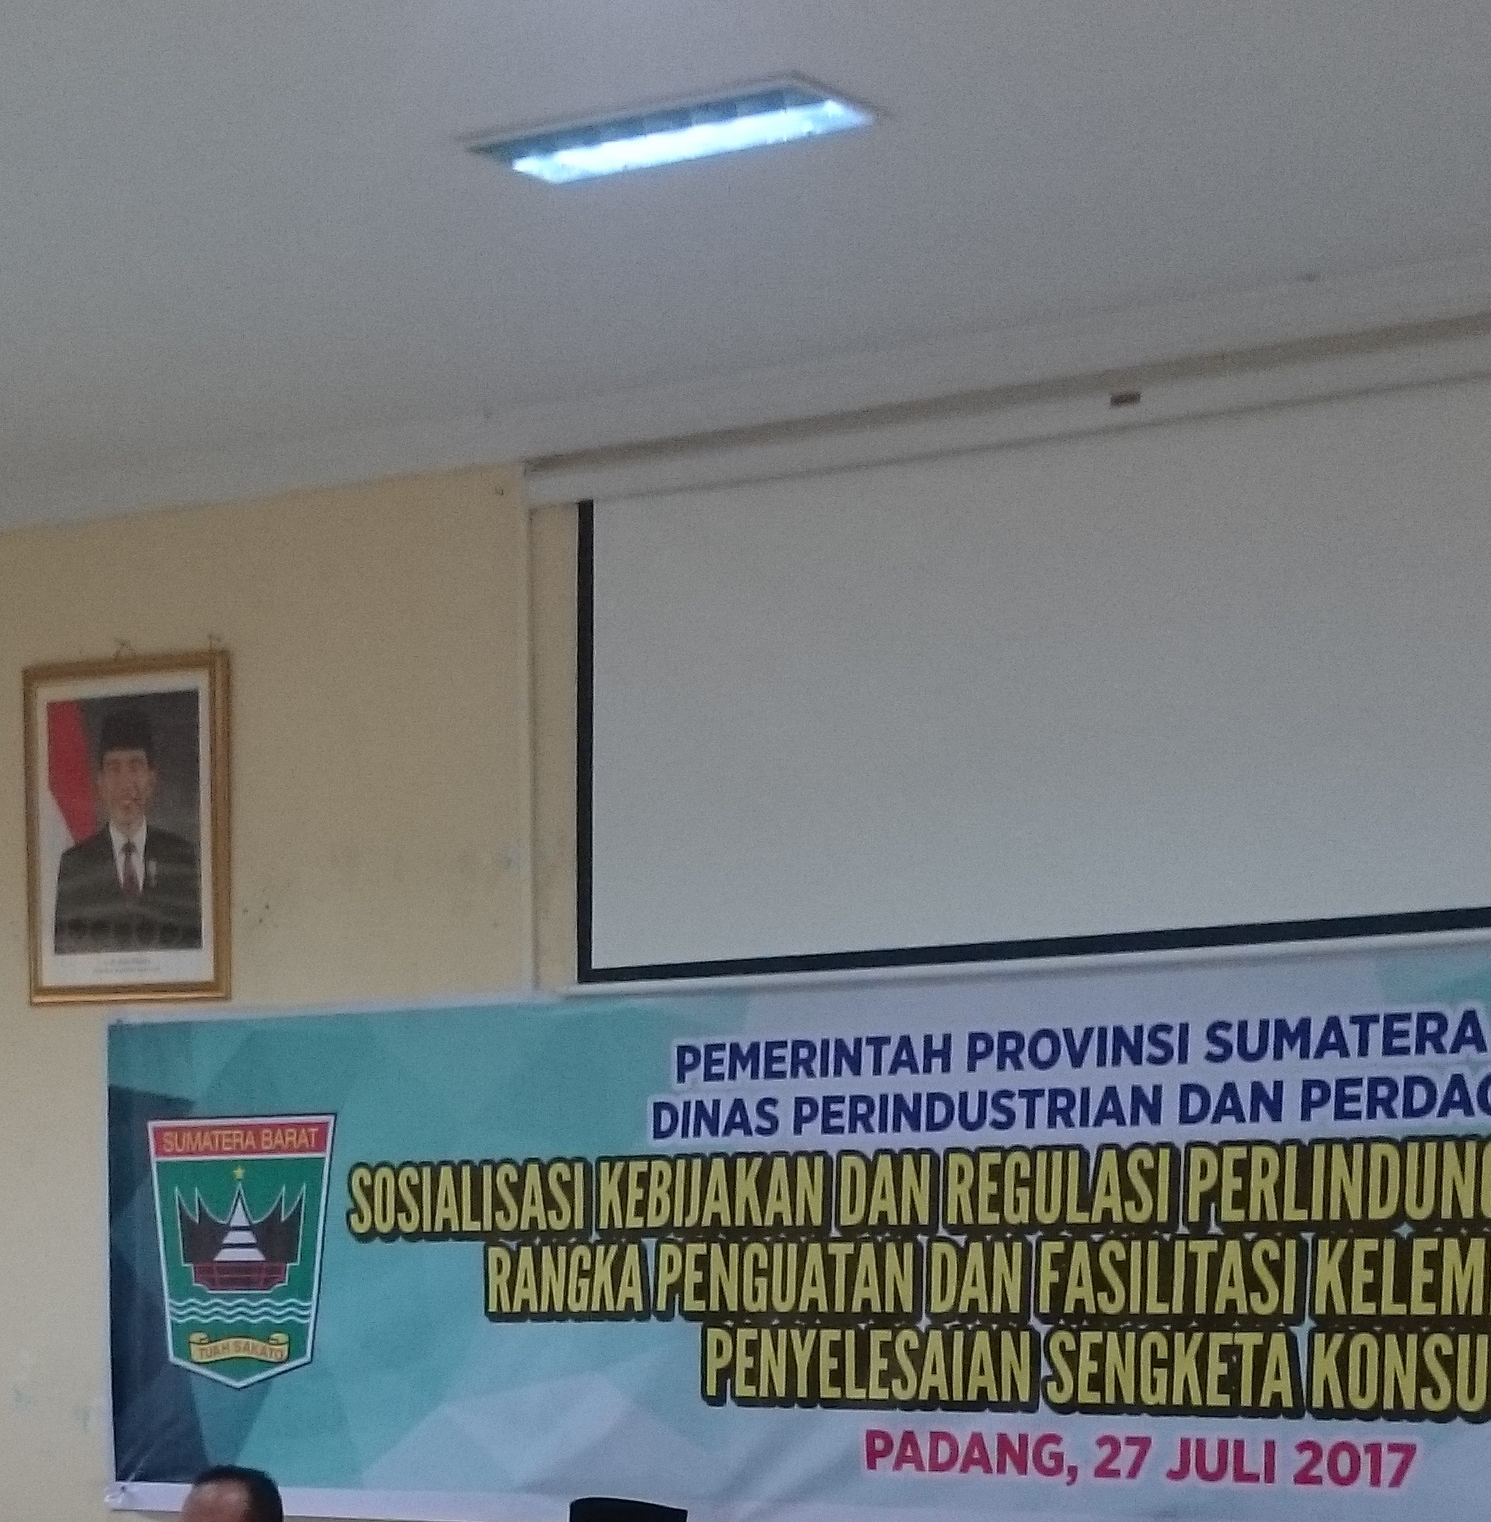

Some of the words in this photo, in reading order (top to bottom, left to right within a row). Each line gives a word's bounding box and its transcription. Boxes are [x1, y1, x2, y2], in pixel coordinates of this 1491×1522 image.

[674, 1034, 952, 1084] PEMERINTAH
[966, 1022, 1189, 1073] PROVINSI
[1204, 1008, 1488, 1063] SUMATERA
[162, 1130, 256, 1152] SUMATERA
[261, 1127, 319, 1150] BARAT
[652, 1096, 780, 1140] DINAS
[792, 1084, 1163, 1138] PERINDUSTRIAN
[1178, 1080, 1285, 1126] DAN
[347, 1163, 586, 1235] SOSIALISASI
[598, 1158, 824, 1232] KEBIJAKAN
[839, 1156, 929, 1227] DAN
[945, 1146, 1170, 1226] REGULASI
[486, 1246, 643, 1313] RANGKA
[656, 1243, 915, 1312] PENGUATAN
[931, 1242, 1023, 1312] DAN
[1039, 1239, 1297, 1315] FASILITASI
[704, 1329, 1031, 1402] PENYELESAIAN
[1043, 1331, 1293, 1406] SENGKETA
[864, 1430, 1079, 1486] PADANG,
[1093, 1437, 1151, 1481] 27
[1165, 1437, 1277, 1484] JULI
[1293, 1440, 1417, 1488] 2017
